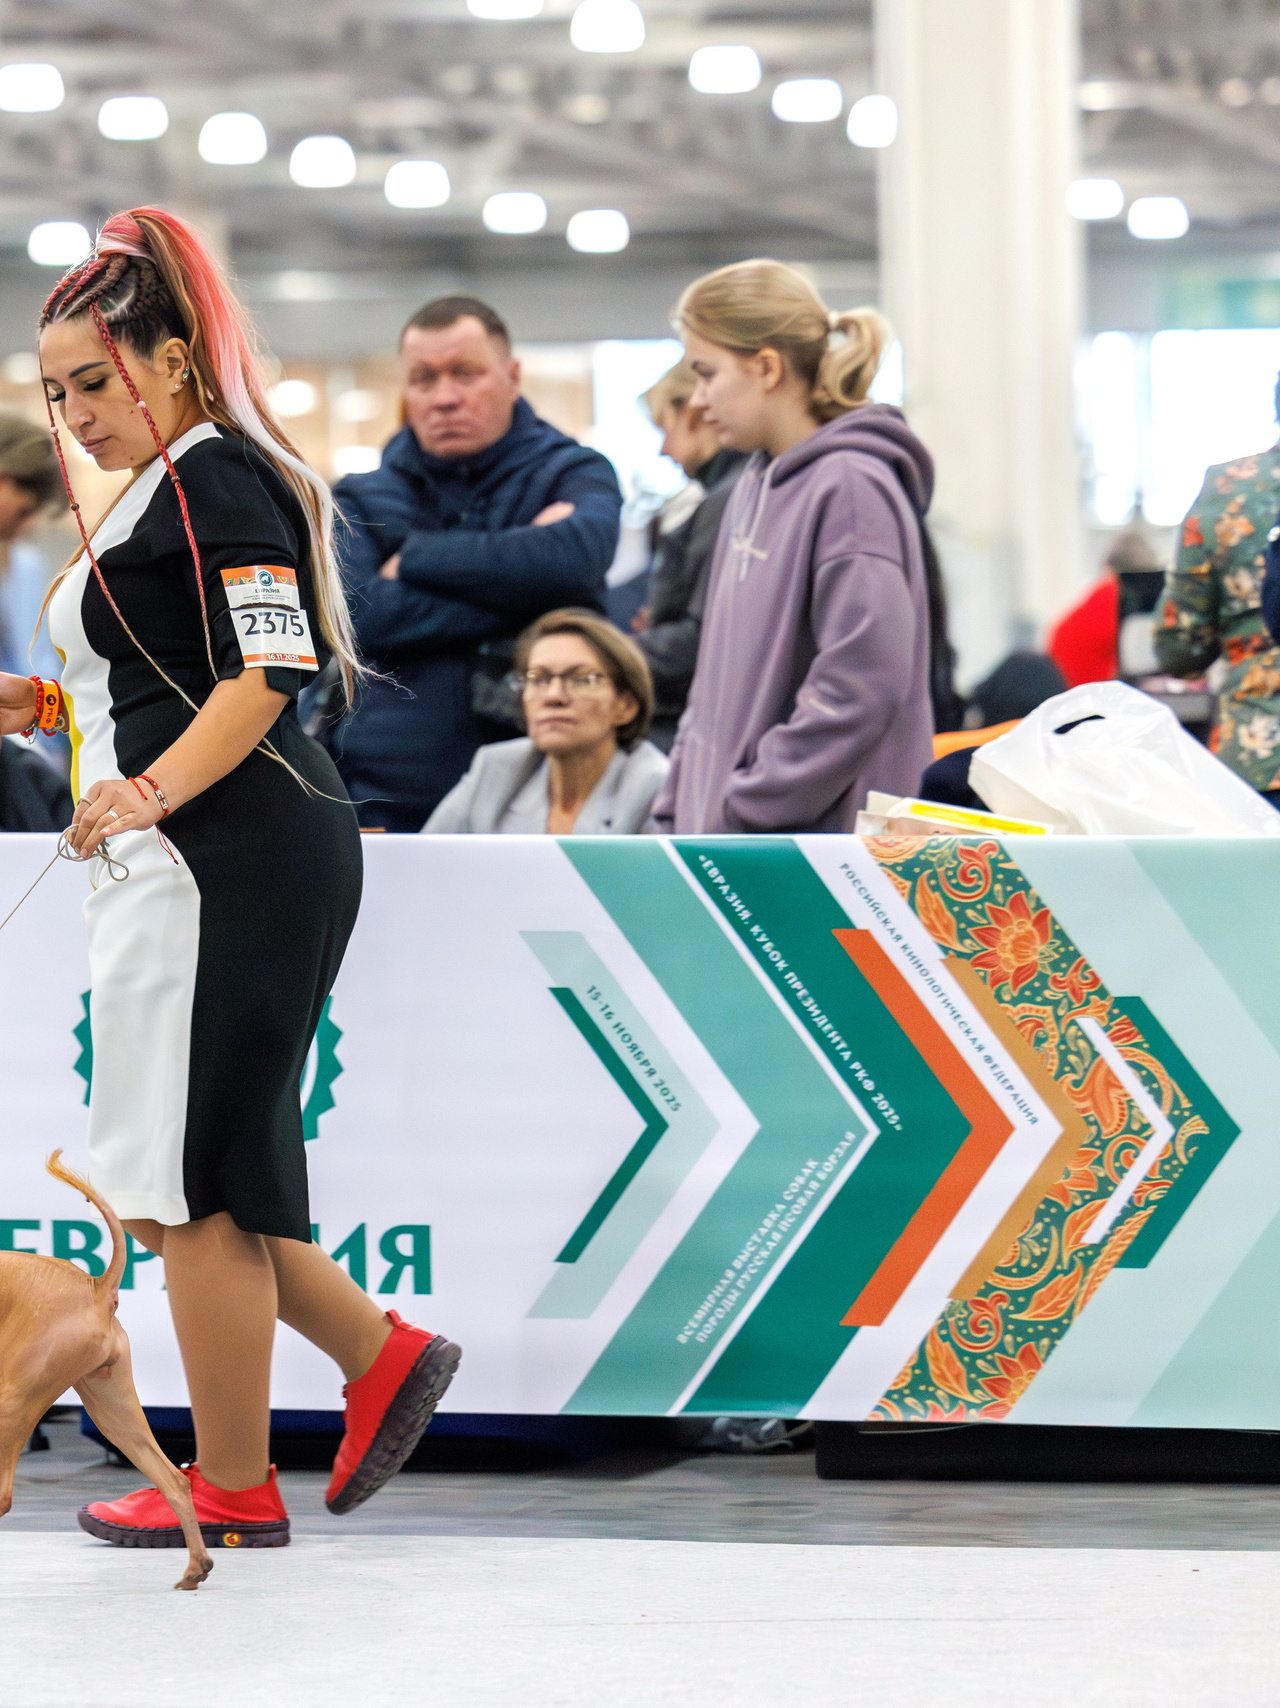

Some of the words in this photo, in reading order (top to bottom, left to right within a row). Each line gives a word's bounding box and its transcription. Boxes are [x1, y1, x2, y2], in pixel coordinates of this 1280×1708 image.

[240, 612, 304, 636] 2375
[267, 653, 299, 662] 16.11.2025
[585, 985, 615, 1021] 15-16
[611, 1021, 657, 1078] НОЯБРЯ
[653, 1078, 682, 1112] 2025
[748, 923, 788, 972] КУБОК
[782, 970, 853, 1062] ПРЕЗИДЕНТА
[847, 1060, 876, 1094] РКФ
[839, 860, 904, 943] РОССИЙСКАЯ
[899, 942, 985, 1053] КИНОЛОГИЧЕСКАЯ
[980, 1052, 1039, 1126] ФЕДЕРАЦИЯ
[695, 1286, 741, 1344] ПОРОДЫ
[735, 1230, 782, 1290] РУССКАЯ
[777, 1179, 820, 1232] ПСОВАЯ
[815, 1130, 856, 1181] БОРЗАЯ
[731, 1200, 786, 1270] ВЫСТАВКА
[781, 1157, 818, 1202] СОБАК
